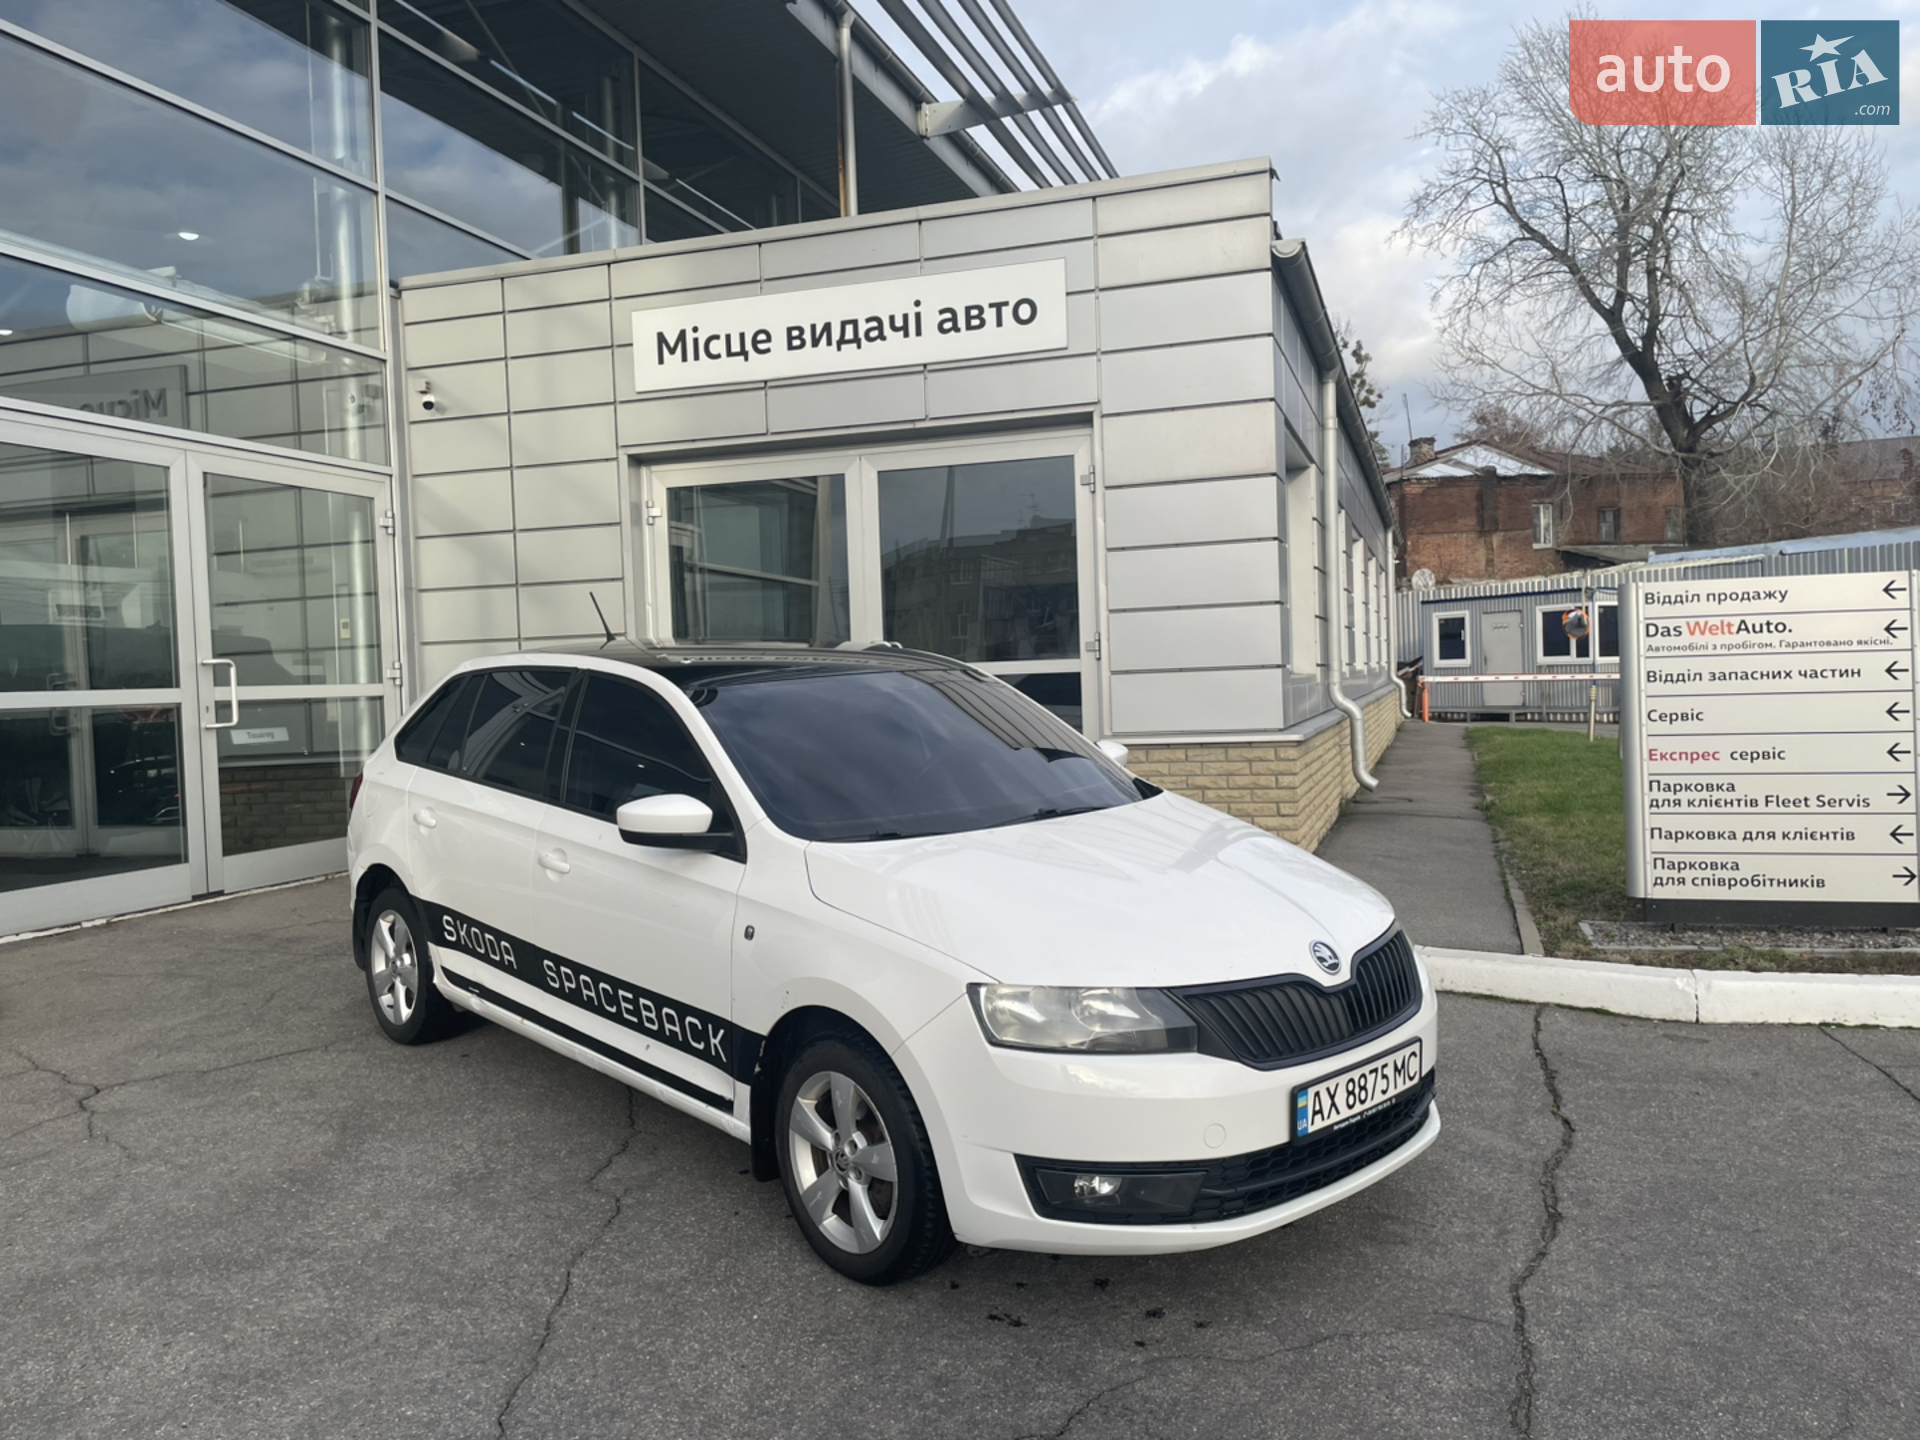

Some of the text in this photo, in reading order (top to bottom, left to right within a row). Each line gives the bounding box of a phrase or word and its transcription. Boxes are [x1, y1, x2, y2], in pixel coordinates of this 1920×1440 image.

[656, 297, 1038, 366] Місце видачі авто
[1644, 588, 1788, 606] Відділ продажу
[1645, 622, 1683, 638] Das
[1646, 636, 1893, 652] Автомобілі з пробігом. Гарантовано якісні.
[1646, 667, 1861, 684] Відділ запасних частин
[1647, 708, 1704, 725] Сервіс
[1648, 746, 1786, 764] Експрес сервіс
[1648, 780, 1736, 796] Парковка
[1649, 794, 1871, 809] для клієнтів Fleet Servis
[1650, 827, 1856, 843] Парковка для клієнтів
[1653, 857, 1740, 873] Парковка
[1653, 873, 1826, 890] для співробітників
[442, 915, 727, 1063] SKODA SPACEBACK
[1311, 1082, 1341, 1126] AX
[1345, 1063, 1390, 1110] 8875
[1394, 1051, 1418, 1090] MC
